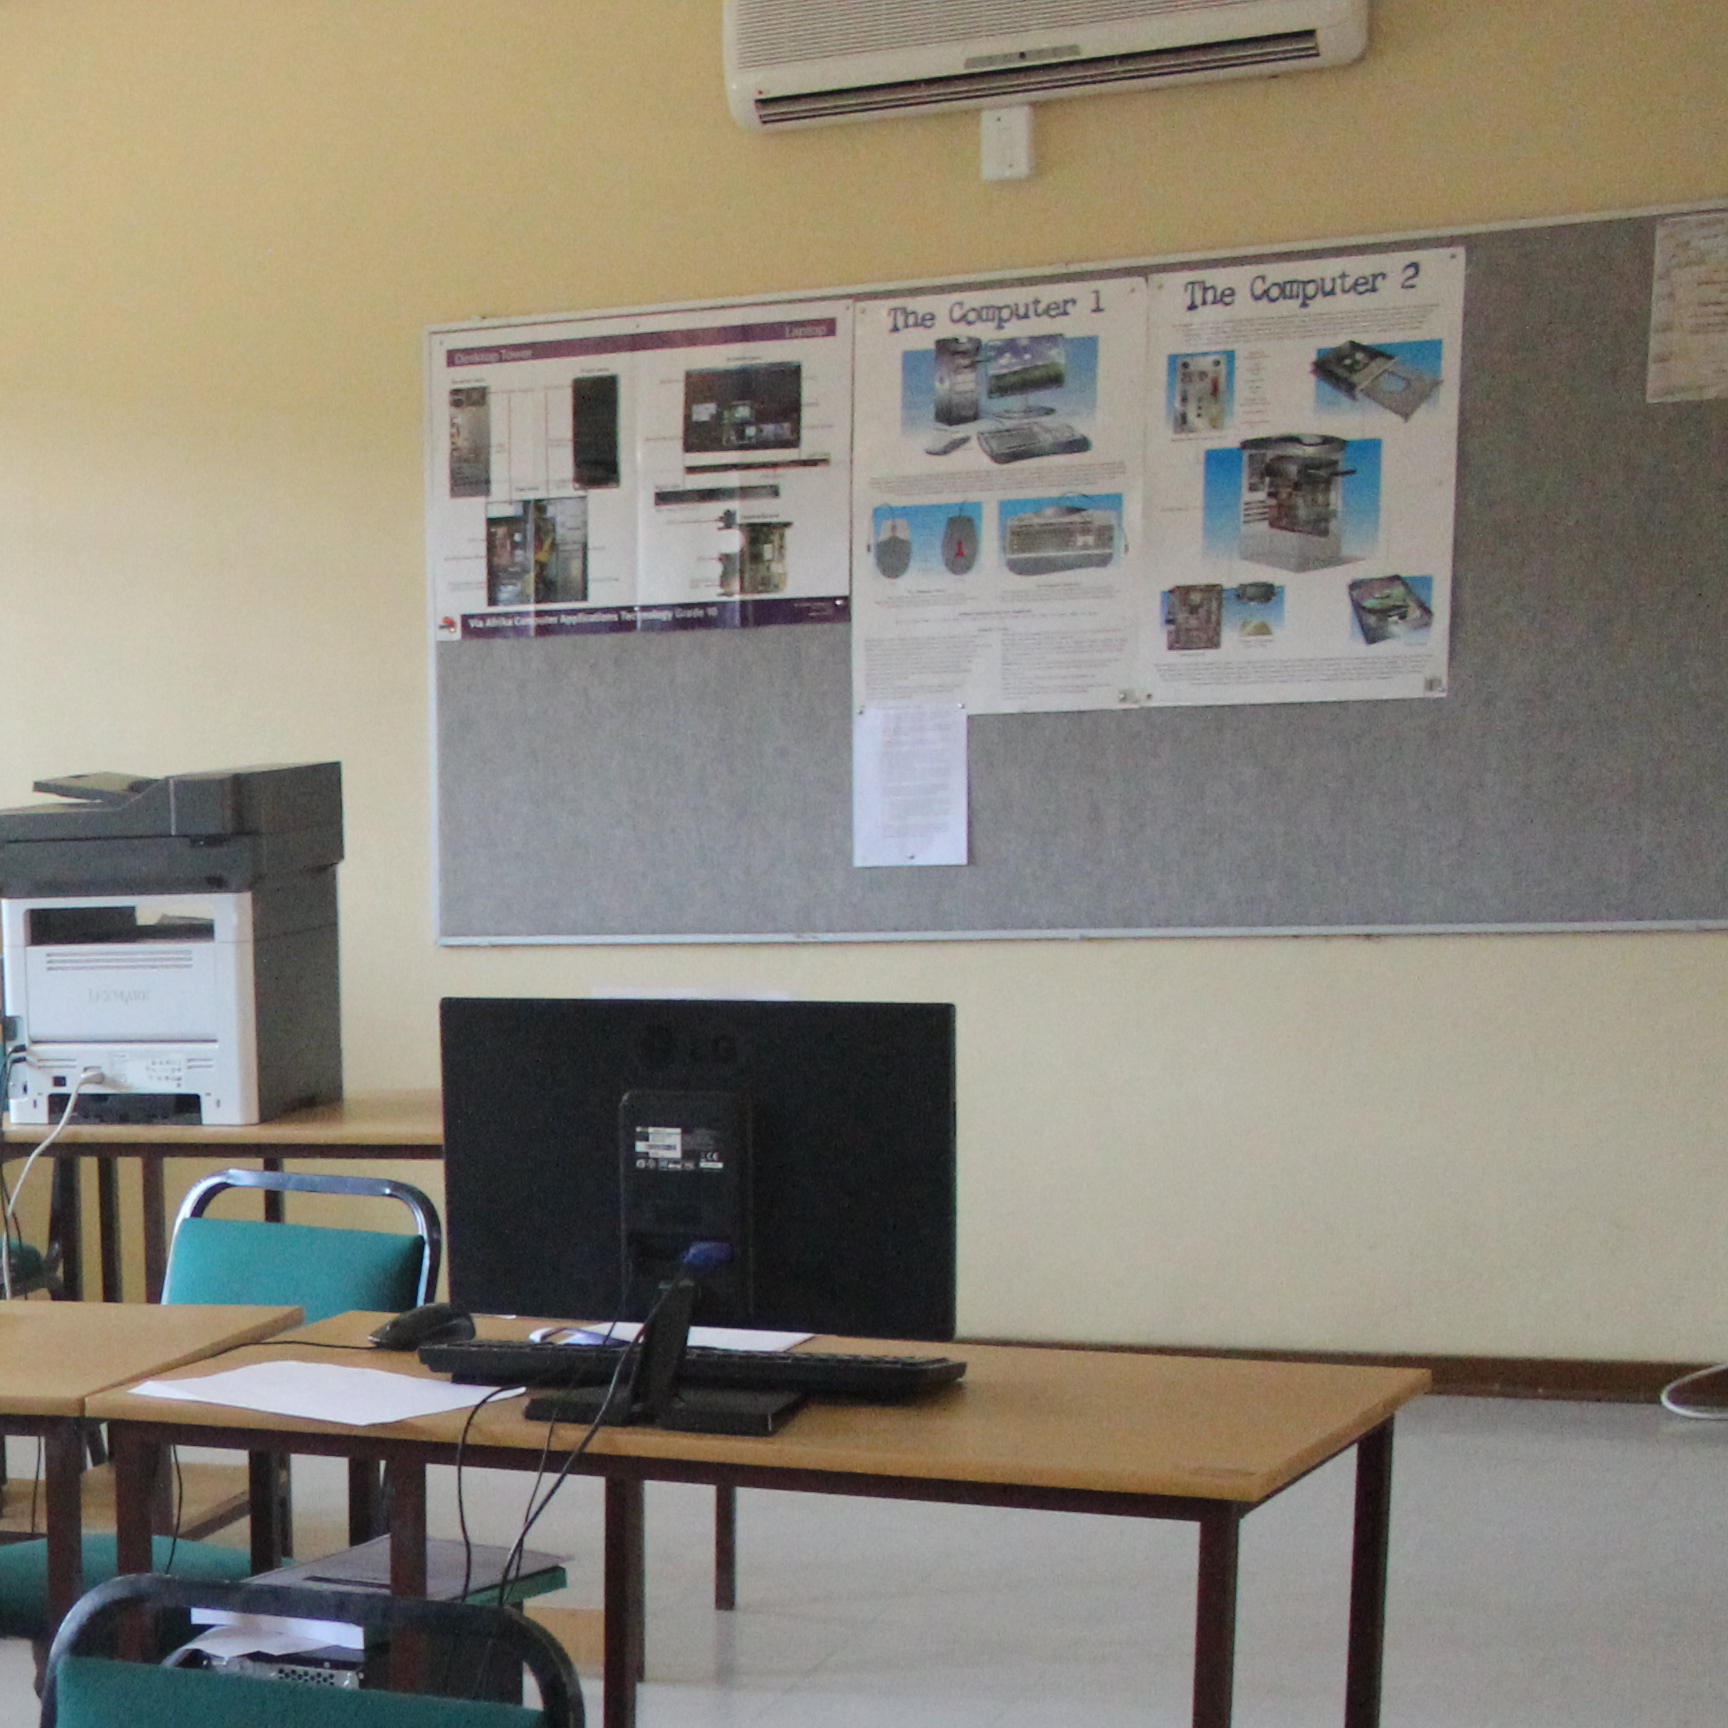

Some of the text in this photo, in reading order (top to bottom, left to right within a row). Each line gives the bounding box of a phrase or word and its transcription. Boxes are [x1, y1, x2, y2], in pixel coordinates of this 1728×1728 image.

[1184, 261, 1421, 311] The Computer 2
[888, 289, 1105, 333] The Computer 1
[501, 349, 533, 361] Tower
[514, 614, 559, 627] Computer
[559, 611, 619, 625] Applications
[619, 609, 673, 622] Technology
